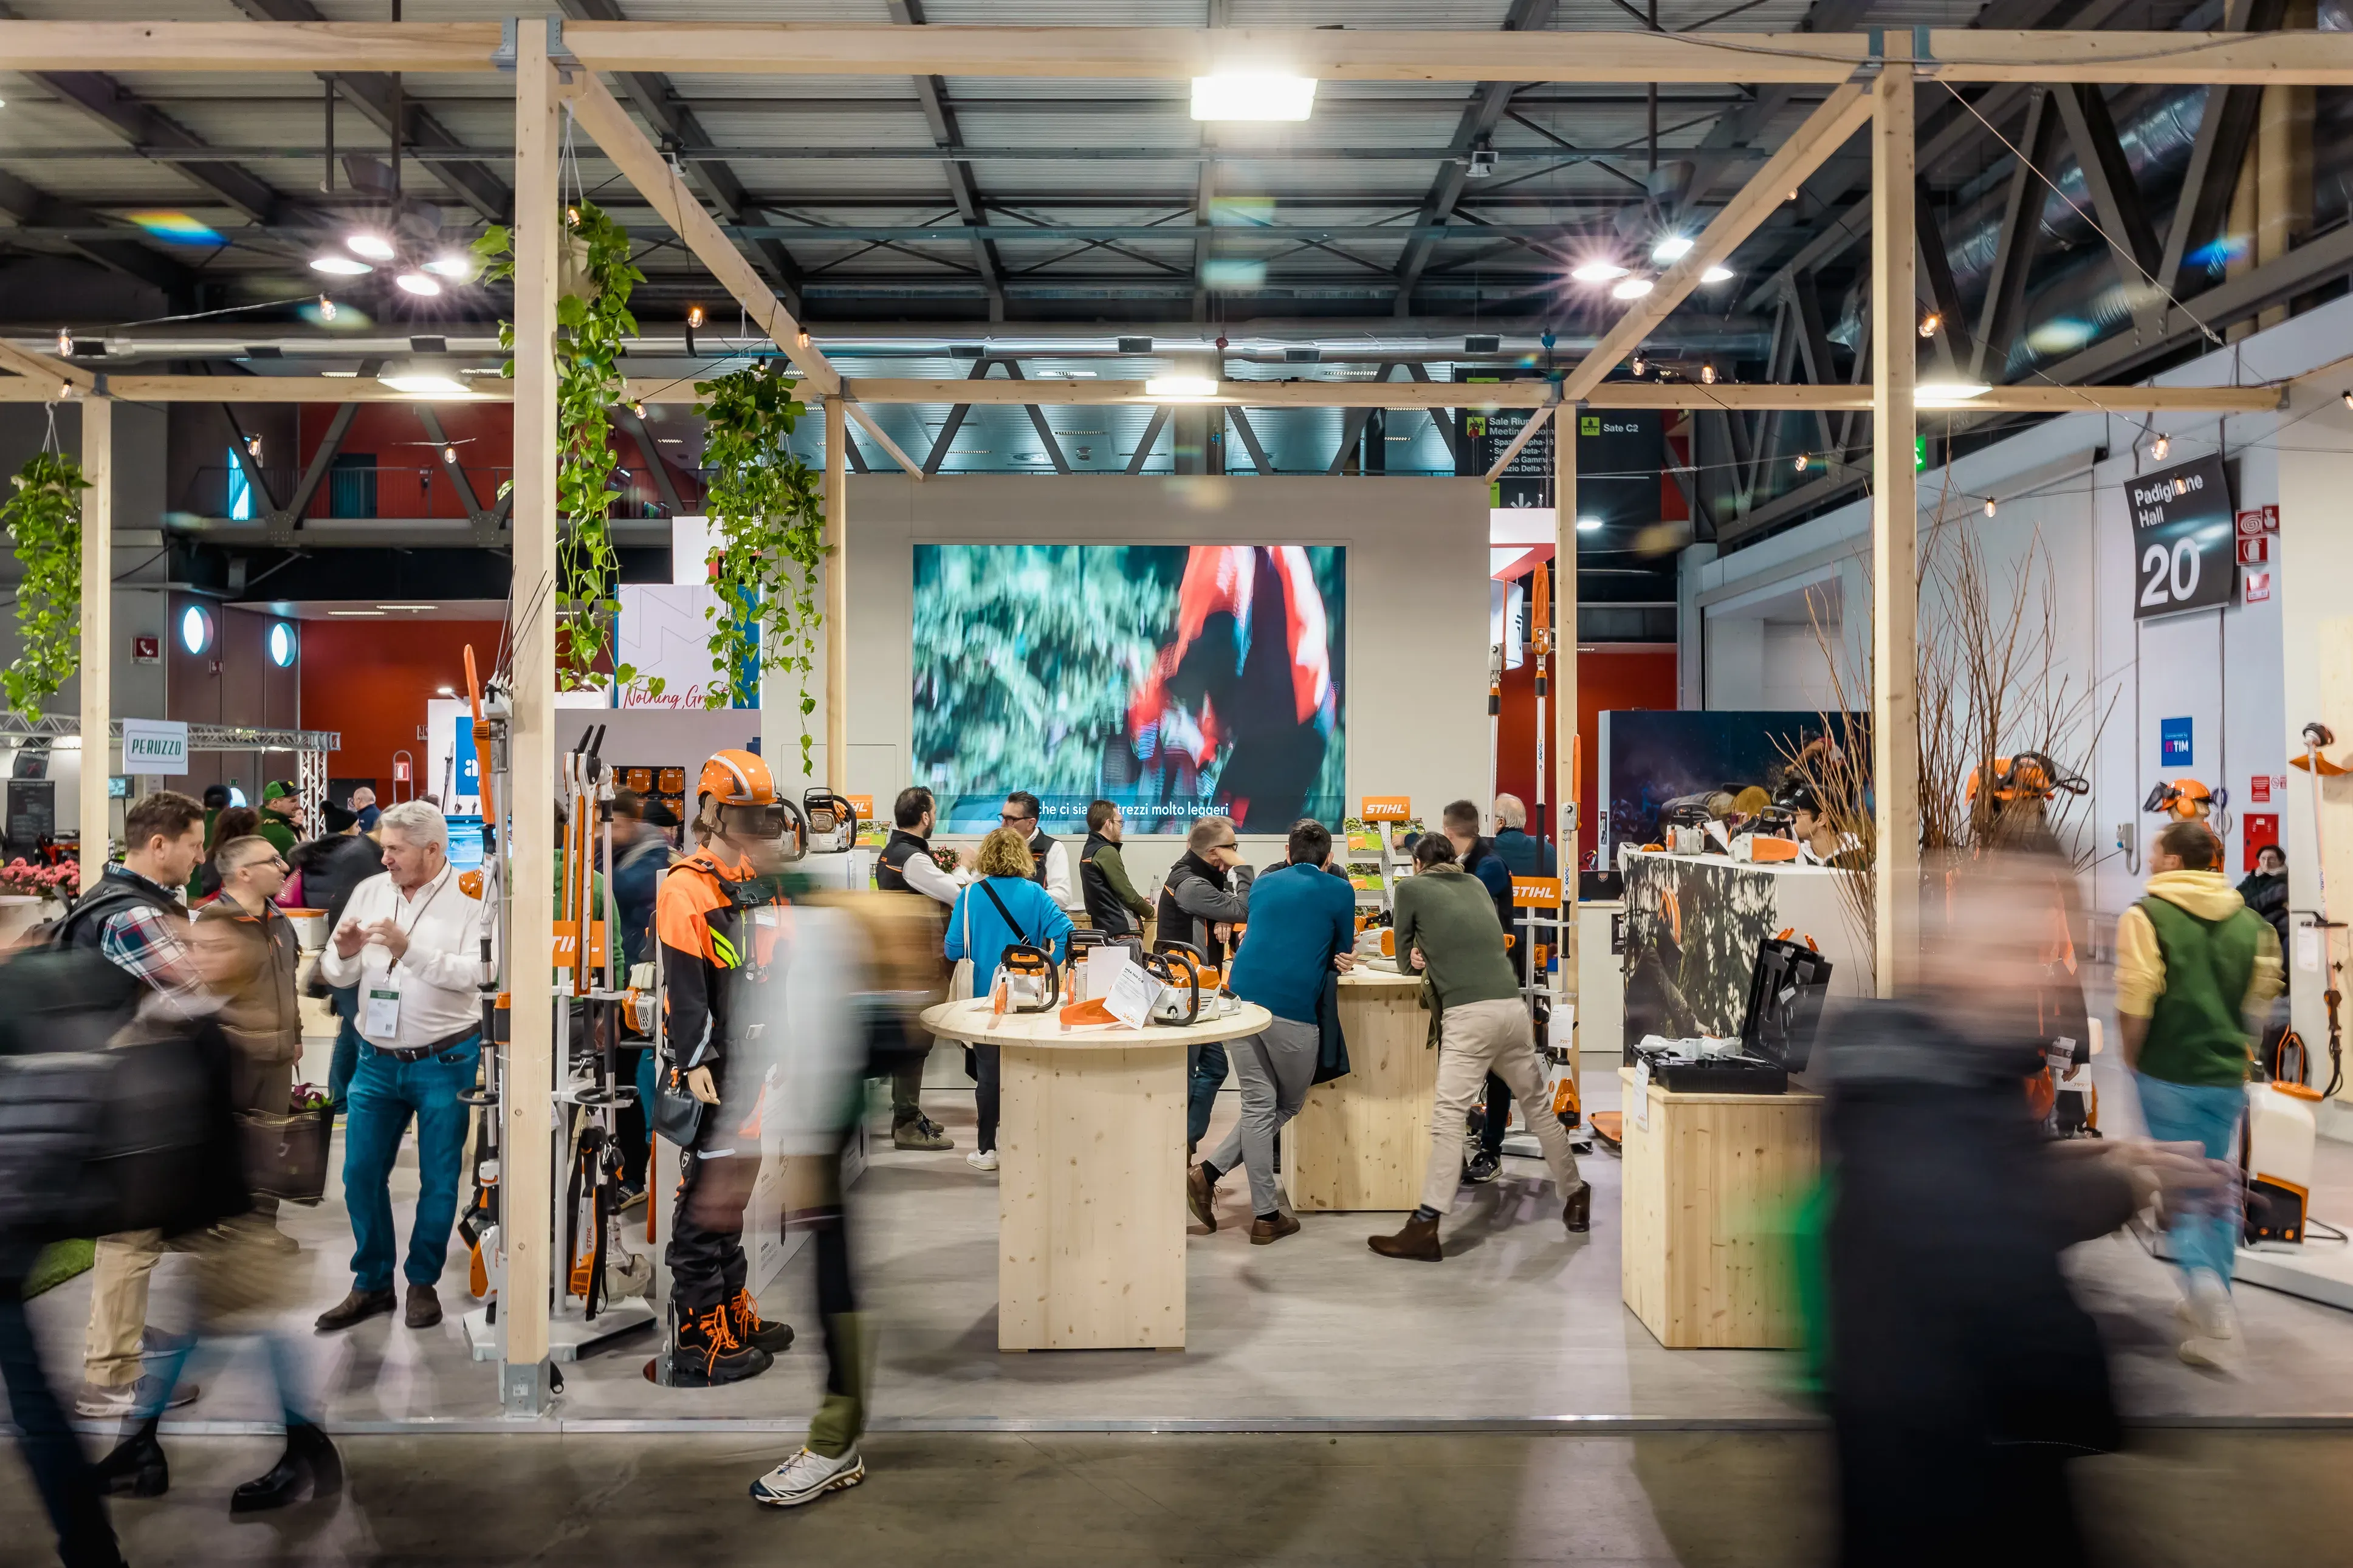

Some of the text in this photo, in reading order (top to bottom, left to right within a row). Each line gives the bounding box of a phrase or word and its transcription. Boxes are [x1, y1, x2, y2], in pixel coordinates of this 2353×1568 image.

[1603, 423, 1639, 433] Sate C2
[2134, 474, 2204, 507] Padiglne
[2138, 504, 2165, 528] Hall
[2140, 536, 2200, 608] 20
[132, 738, 182, 755] PERUZZO
[2173, 739, 2189, 753] TIM
[1059, 803, 1070, 815] ci
[1152, 801, 1185, 815] molto
[1187, 801, 1228, 818] leggeri
[1365, 804, 1406, 814] STIHL
[1512, 886, 1555, 899] STIHL
